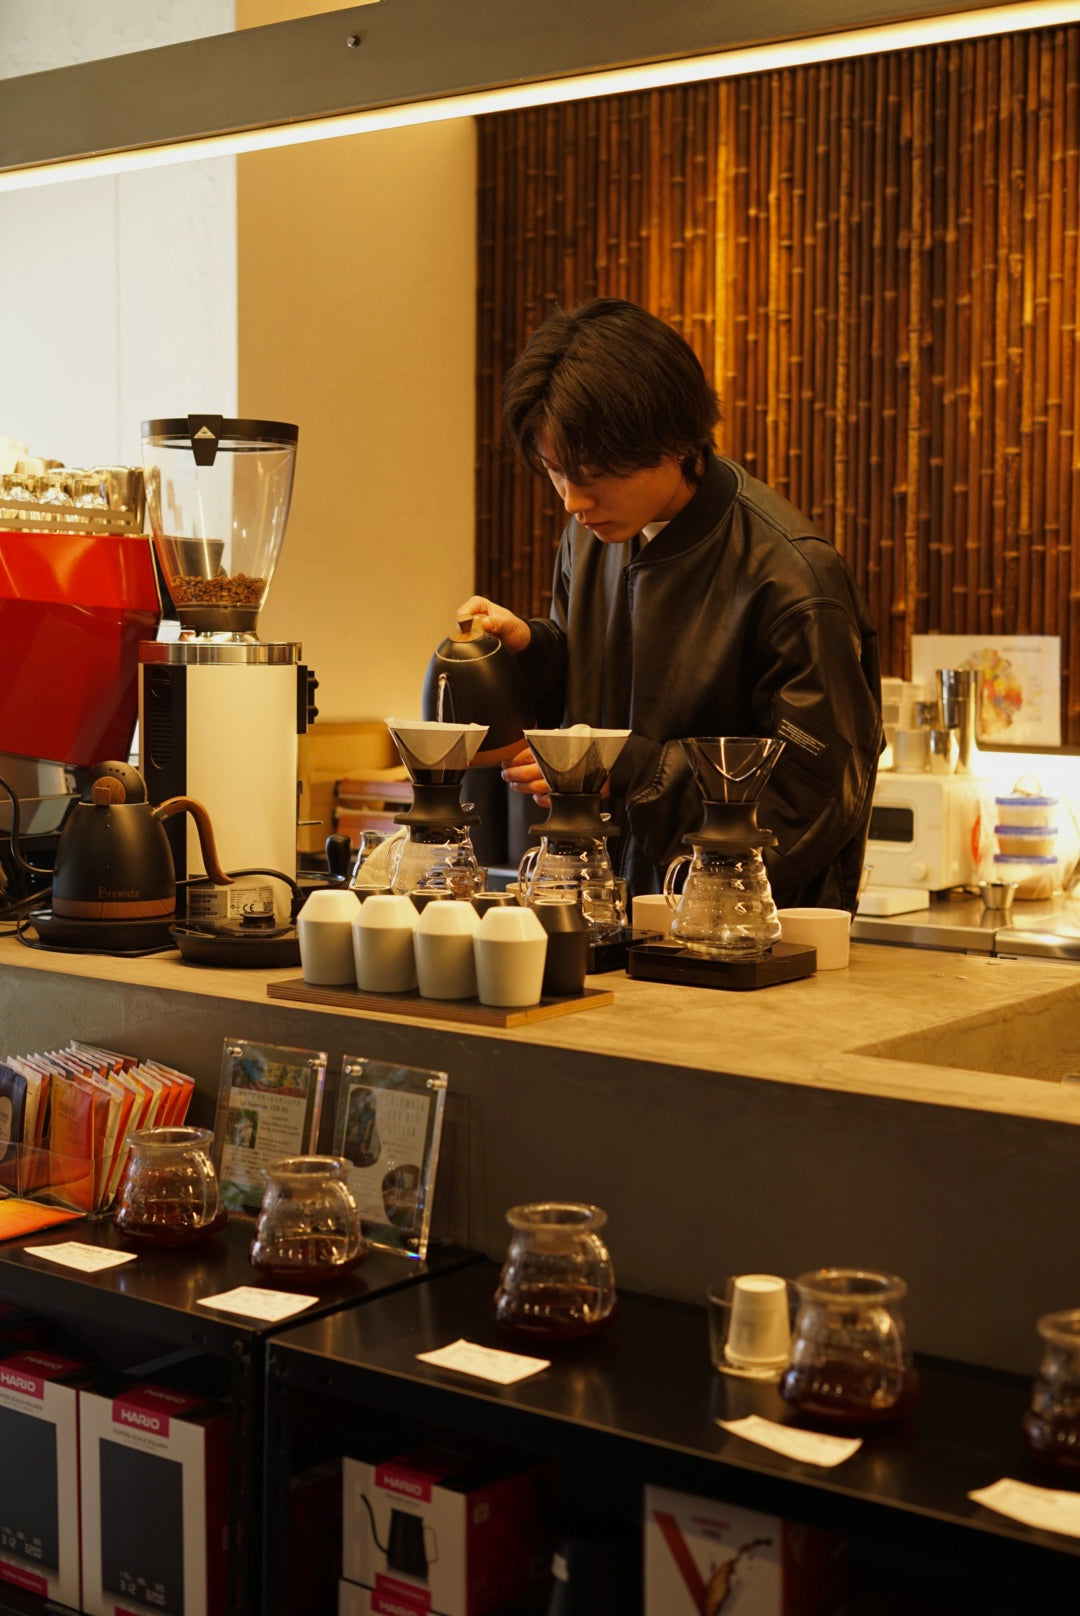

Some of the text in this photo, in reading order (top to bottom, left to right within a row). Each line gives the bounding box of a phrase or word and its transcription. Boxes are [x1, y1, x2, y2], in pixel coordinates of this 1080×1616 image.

[98, 886, 140, 898] Brewista
[0, 1371, 36, 1393] HARIO
[121, 1408, 161, 1431] HARIO
[383, 1475, 423, 1496] HARIO
